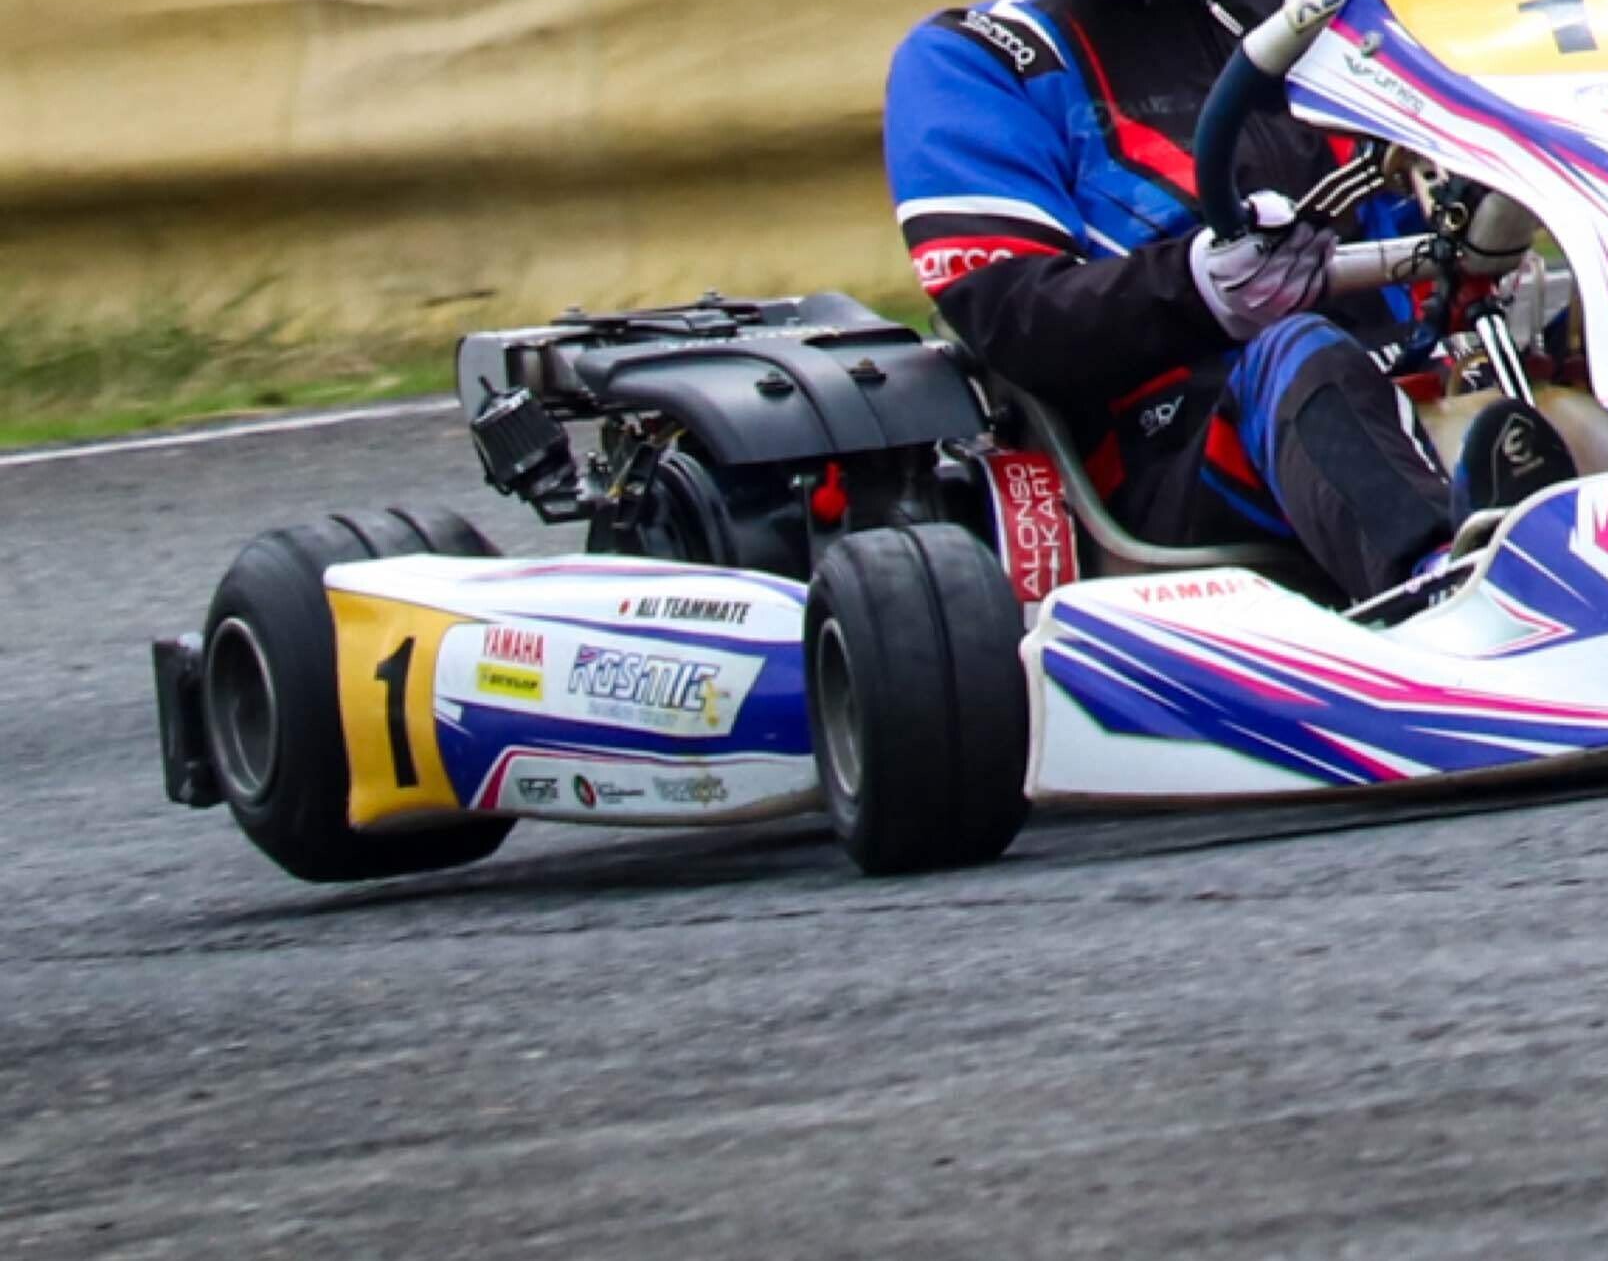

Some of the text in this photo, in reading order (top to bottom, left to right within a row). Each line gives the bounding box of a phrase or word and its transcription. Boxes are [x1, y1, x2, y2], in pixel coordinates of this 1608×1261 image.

[960, 10, 1036, 73] sparco
[1004, 463, 1041, 597] ALONSO
[1028, 463, 1060, 547] KART
[484, 626, 544, 664] YAMAHA
[662, 597, 751, 624] TEAMMATE
[374, 637, 420, 787] 1
